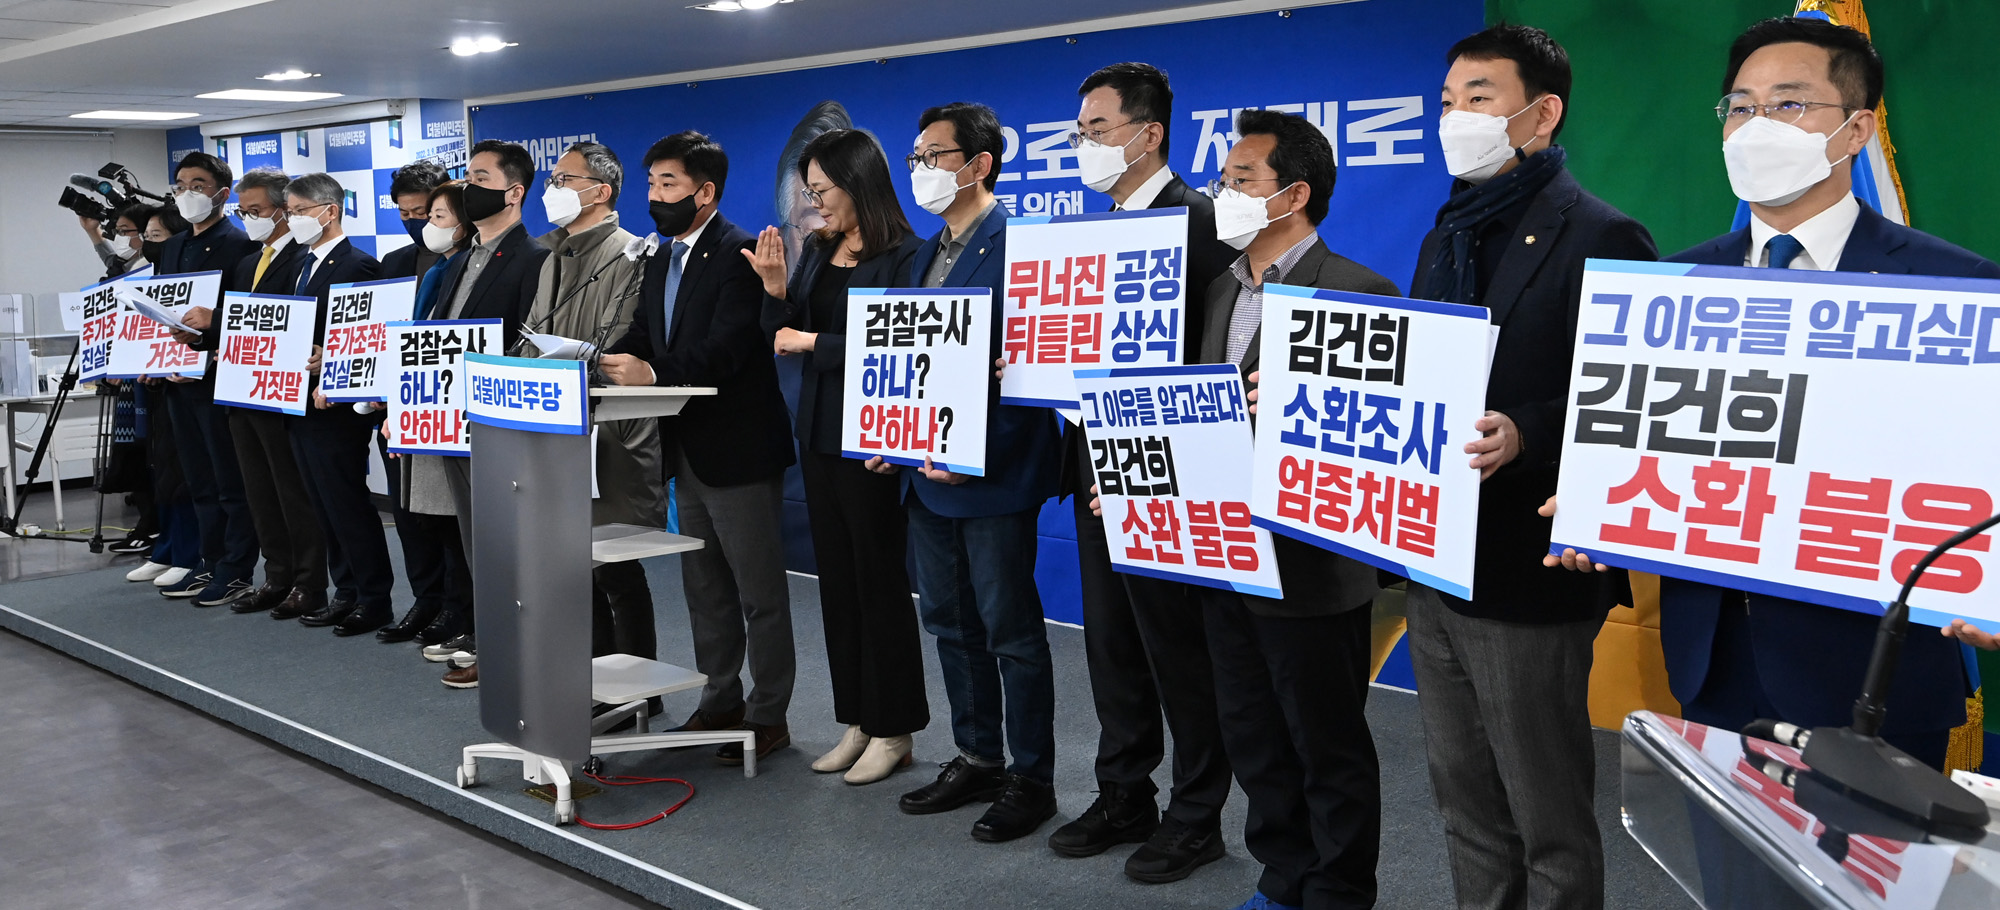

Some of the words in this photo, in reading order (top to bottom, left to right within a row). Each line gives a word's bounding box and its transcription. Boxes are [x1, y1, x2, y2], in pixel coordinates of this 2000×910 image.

[245, 139, 278, 156] 더불어민주당
[329, 130, 366, 148] 더불어민주당
[1008, 254, 1106, 309] 무너진
[1114, 246, 1183, 304] 공정
[83, 312, 117, 346] 주가조
[227, 303, 290, 332] 윤석열의
[331, 291, 373, 325] 김건희
[866, 298, 972, 347] 검찰수사
[1583, 293, 1633, 346] 그
[1643, 295, 1793, 356] 이유를
[223, 335, 276, 366] 새빨간
[400, 327, 487, 367] 검찰수사
[1005, 312, 1103, 365] 뒤틀린
[1111, 308, 1179, 363] 상식
[1288, 309, 1409, 386] 김건희
[250, 370, 303, 403] 거짓말
[322, 357, 376, 391] 진실은?!
[400, 369, 453, 405] 하나?
[472, 375, 562, 412] 더불어민주당
[862, 353, 931, 399] 하나?
[1081, 392, 1103, 428] 그
[1102, 386, 1157, 427] 이유를
[1157, 379, 1246, 425] 알고싶다!
[1573, 362, 1809, 465] 김건희
[859, 404, 954, 454] 안하나?
[1280, 383, 1448, 475] 소환조사
[1090, 435, 1180, 497] 김건희
[1276, 455, 1440, 558] 엄중처벌
[1599, 455, 1777, 565] 소환
[1794, 471, 1994, 594] 불응
[1121, 498, 1184, 565] 소환
[1186, 499, 1259, 572] 불응
